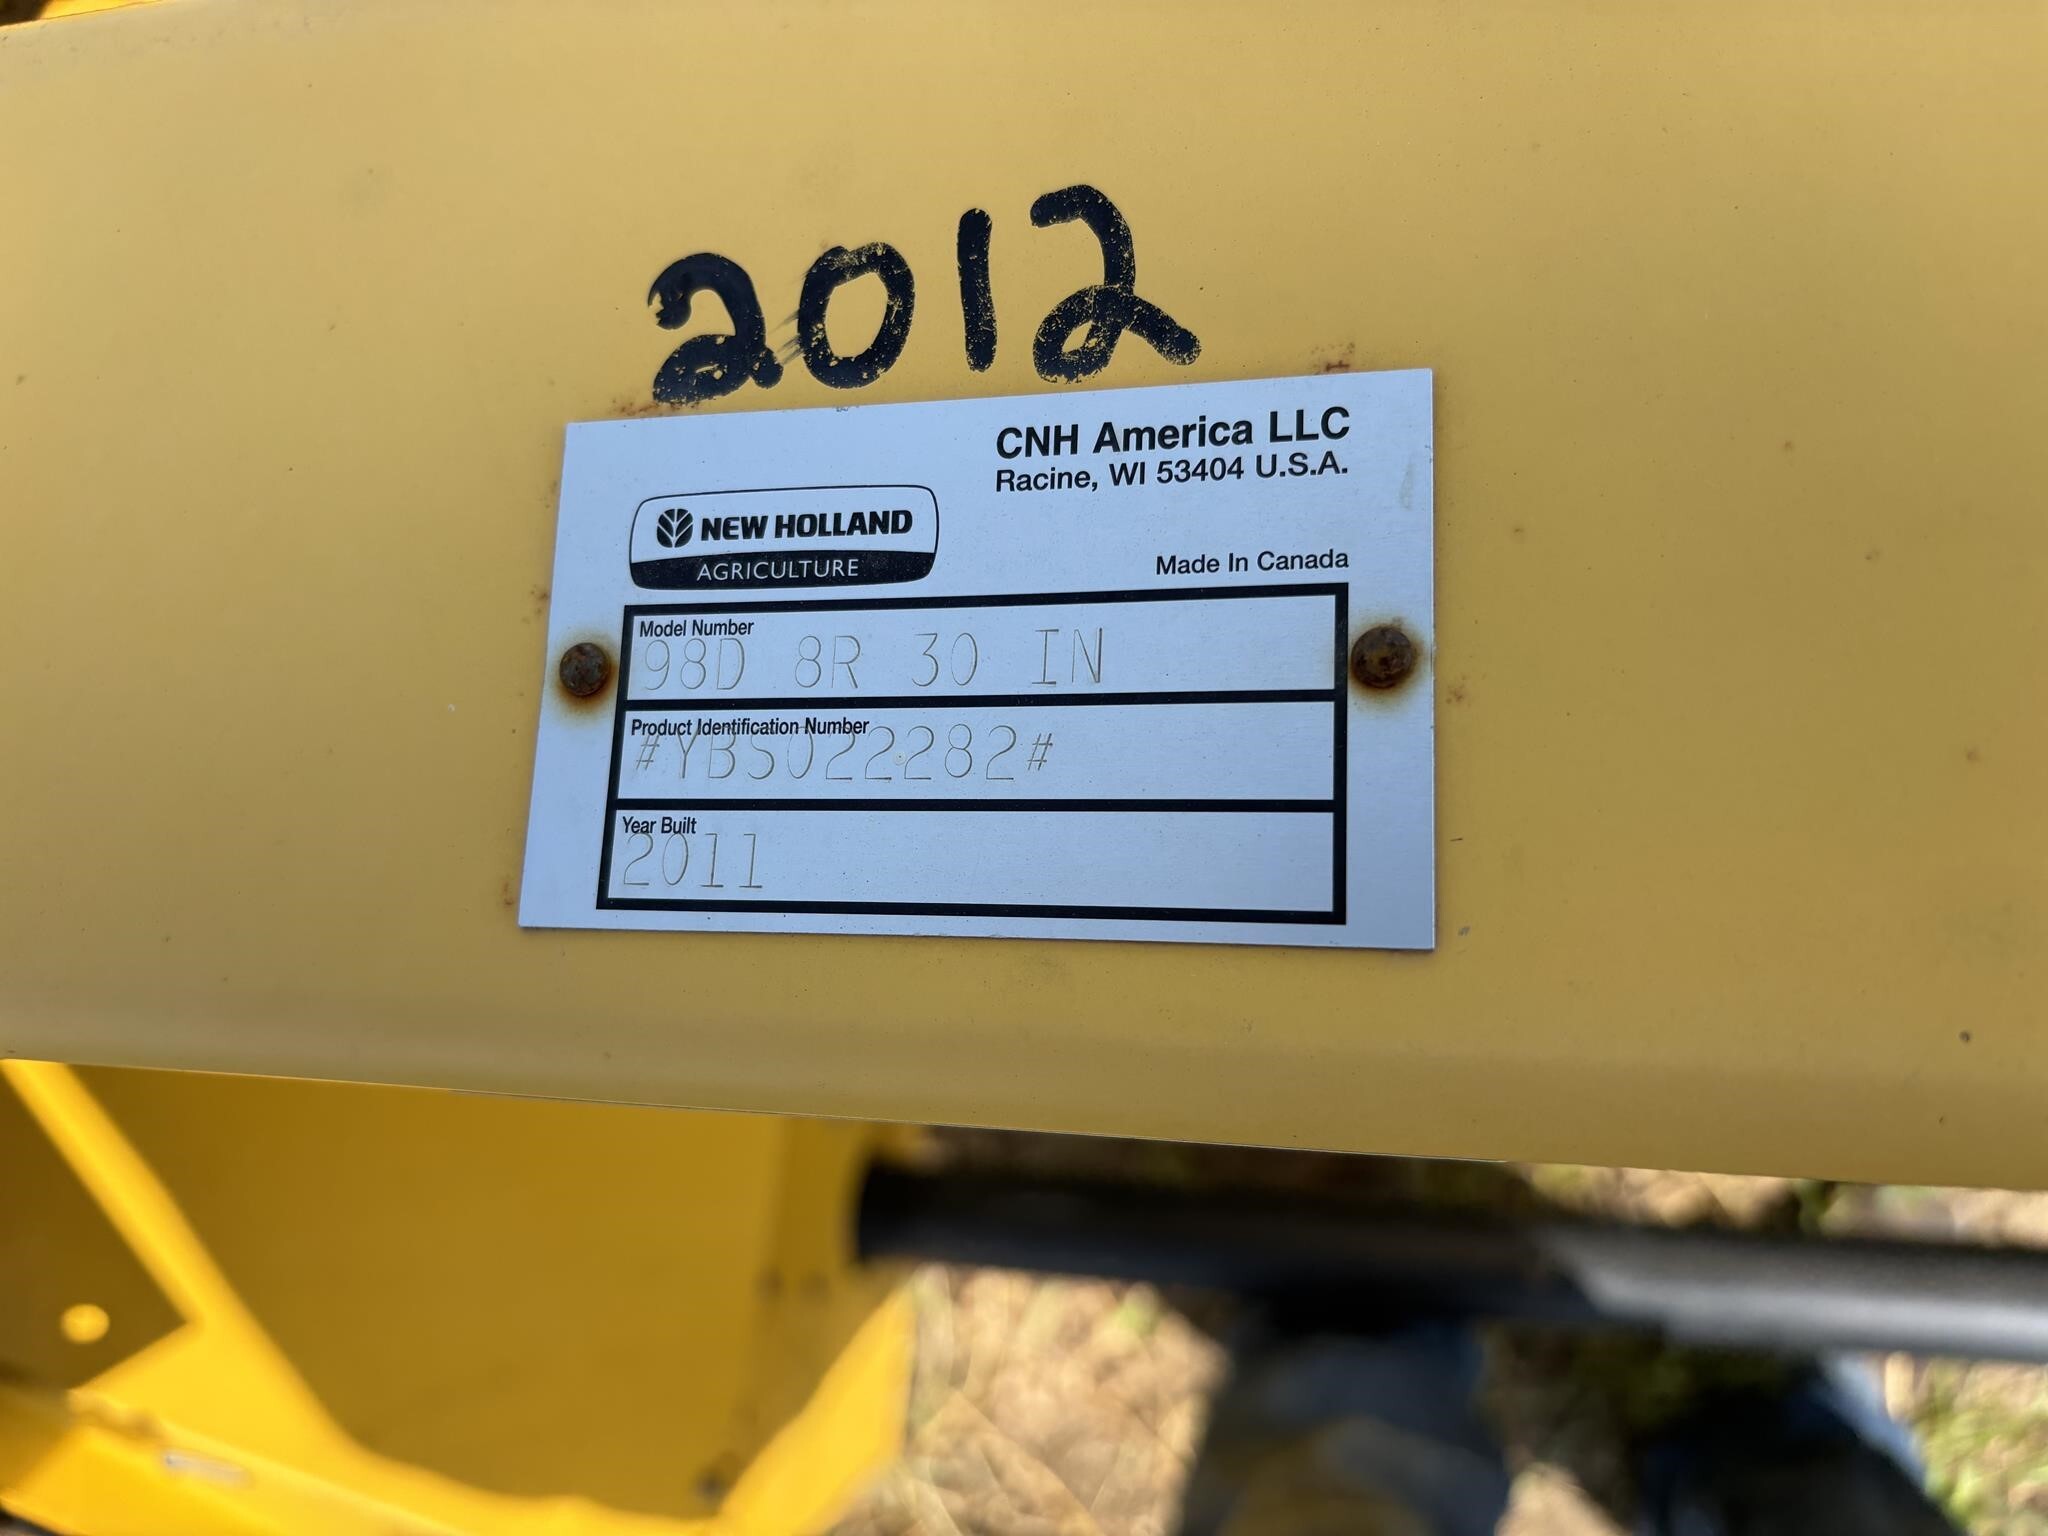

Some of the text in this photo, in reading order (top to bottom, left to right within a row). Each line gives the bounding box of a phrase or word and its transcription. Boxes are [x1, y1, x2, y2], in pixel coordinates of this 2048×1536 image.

[647, 184, 1202, 404] 2012
[996, 406, 1350, 459] CNH America LLC
[996, 450, 1349, 492] Racine, WI 53404 U.S.A.
[701, 509, 913, 541] NEW HOLLAND
[697, 558, 859, 582] AGRICULTURE
[1155, 548, 1350, 575] Made In Canada
[639, 618, 754, 638] Model Number
[644, 627, 1103, 690] 98D 8R 30 IN
[631, 716, 869, 737] Product Identification Number
[622, 815, 697, 834] Year Built
[623, 831, 763, 889] 2011
